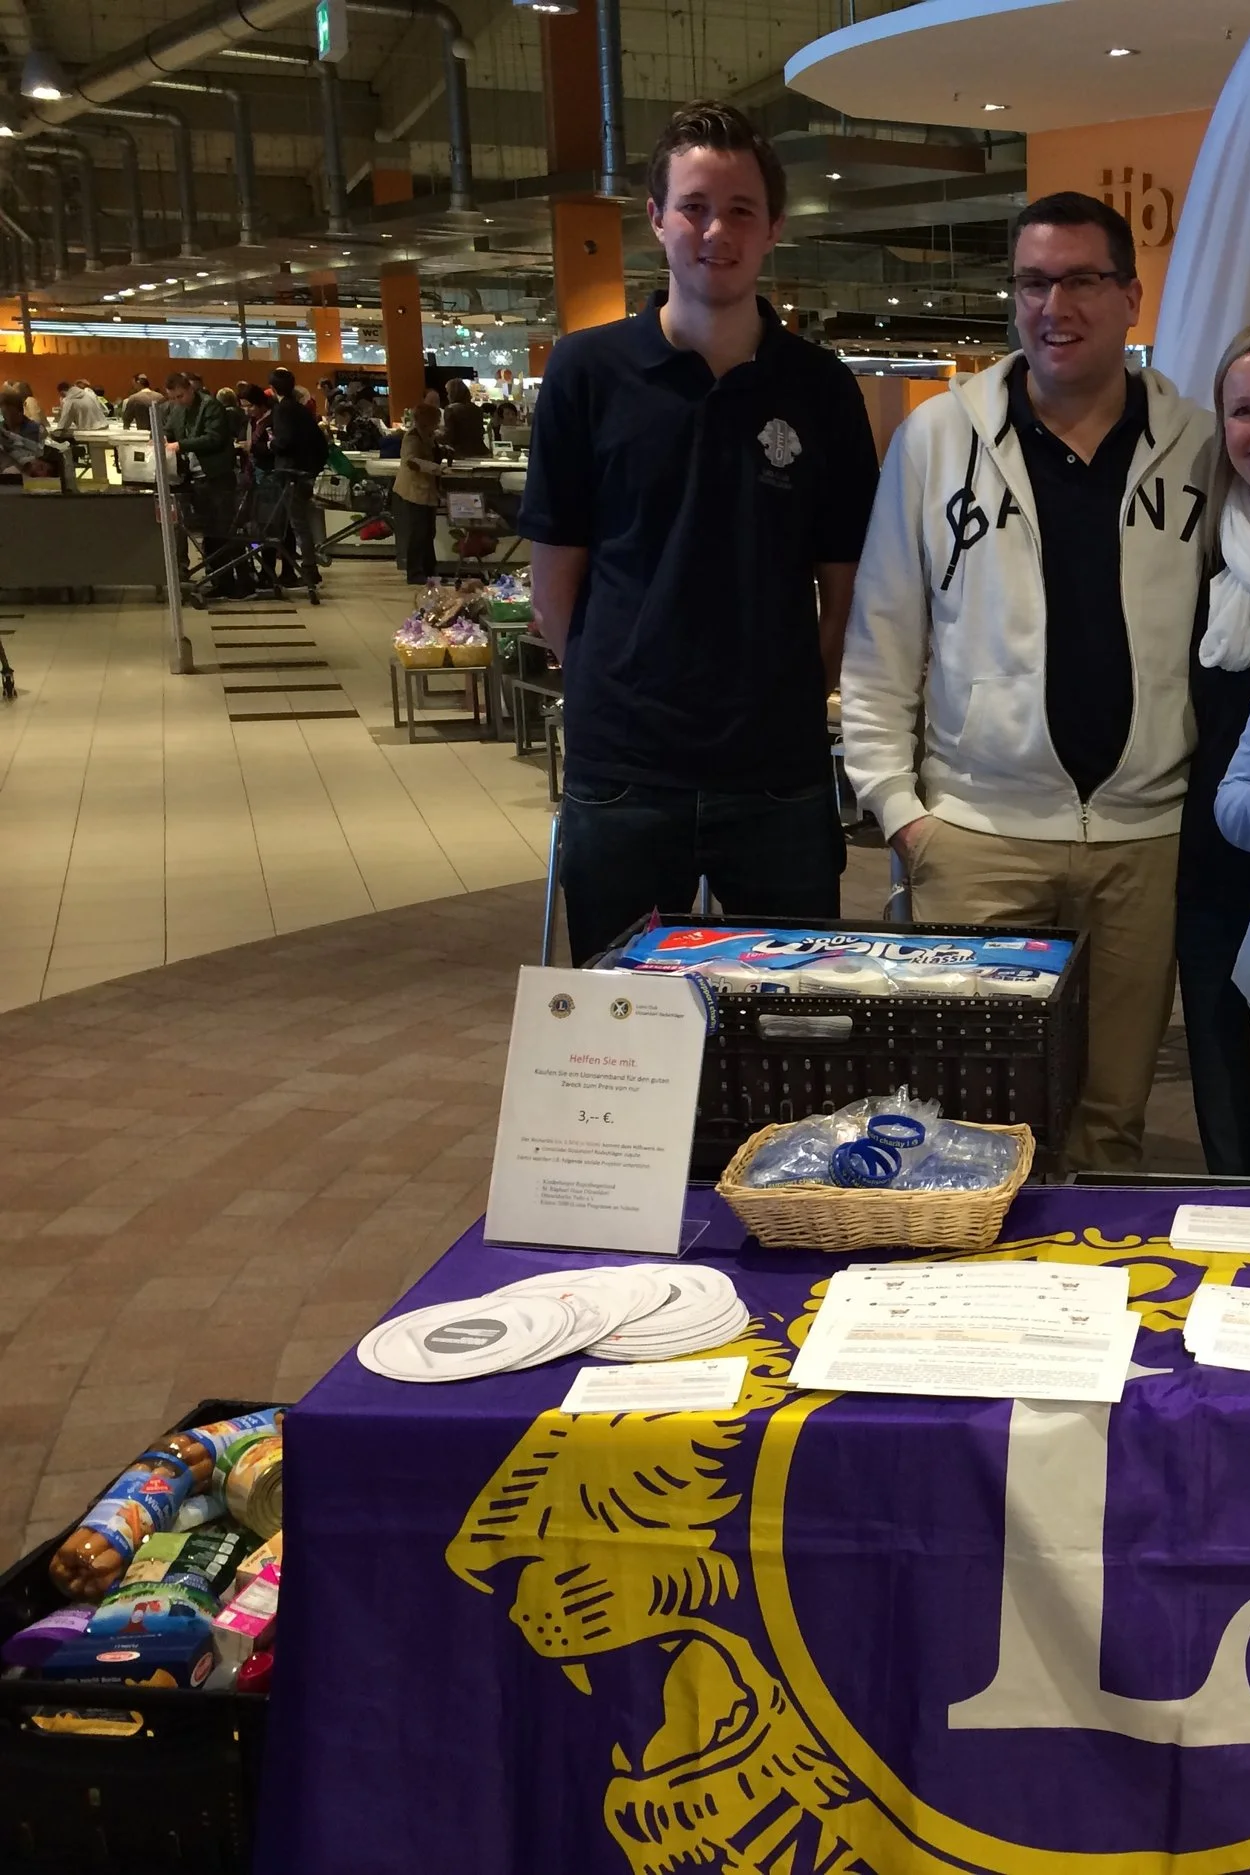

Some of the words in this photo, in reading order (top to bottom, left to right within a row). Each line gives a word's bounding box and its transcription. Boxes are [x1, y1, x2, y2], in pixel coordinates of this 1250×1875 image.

[362, 328, 380, 337] WC
[569, 1054, 600, 1065] Helfen
[602, 1056, 617, 1066] Sie
[534, 1068, 557, 1077] Kaufen
